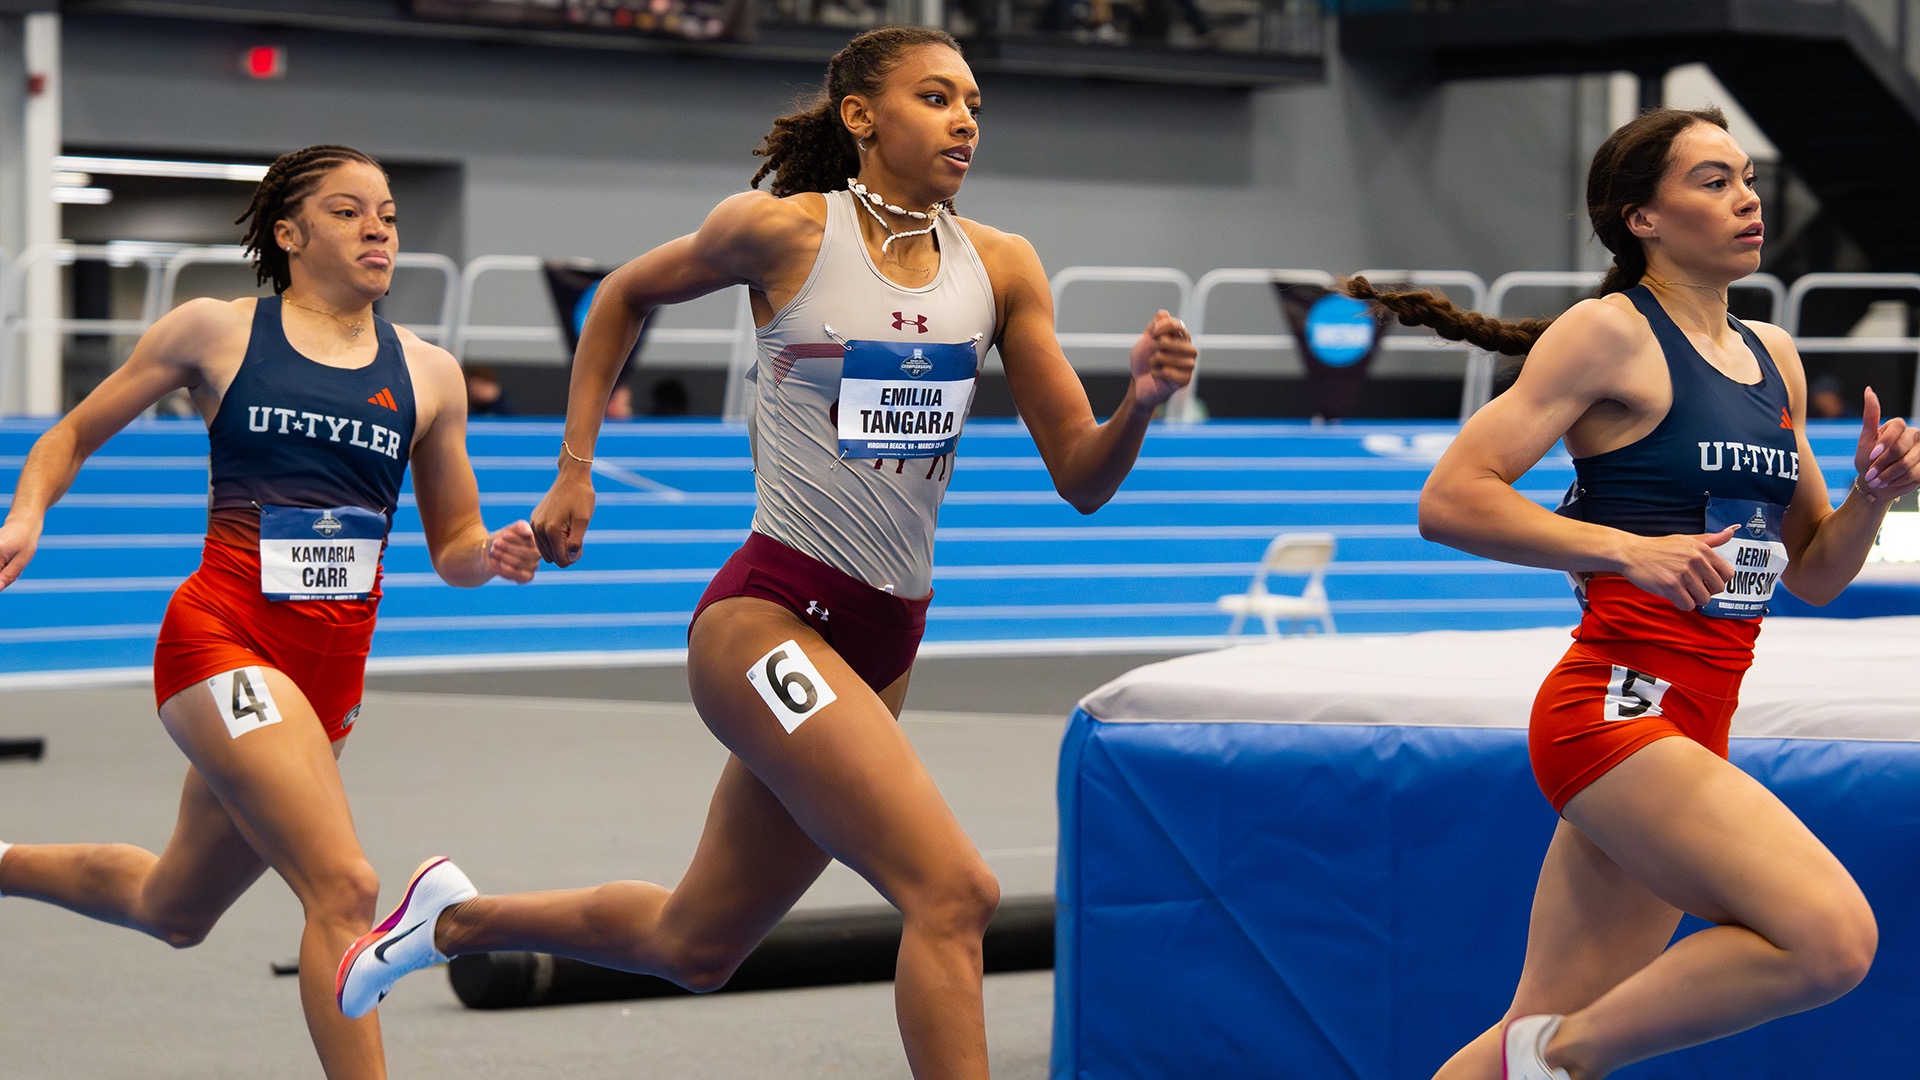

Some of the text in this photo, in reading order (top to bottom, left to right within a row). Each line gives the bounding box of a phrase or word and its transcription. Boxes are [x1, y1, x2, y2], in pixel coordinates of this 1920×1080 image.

[880, 388, 942, 406] EMILIIA
[860, 410, 954, 435] TANGARA
[302, 412, 401, 460] TYLER
[889, 442, 907, 450] BEACH,
[1746, 444, 1800, 481] TYLE
[291, 546, 355, 563] KAMARIA
[1735, 546, 1771, 568] AERIN
[302, 567, 348, 588] CARR
[766, 650, 818, 714] 6
[1617, 668, 1657, 717] 5
[232, 669, 268, 723] 4
